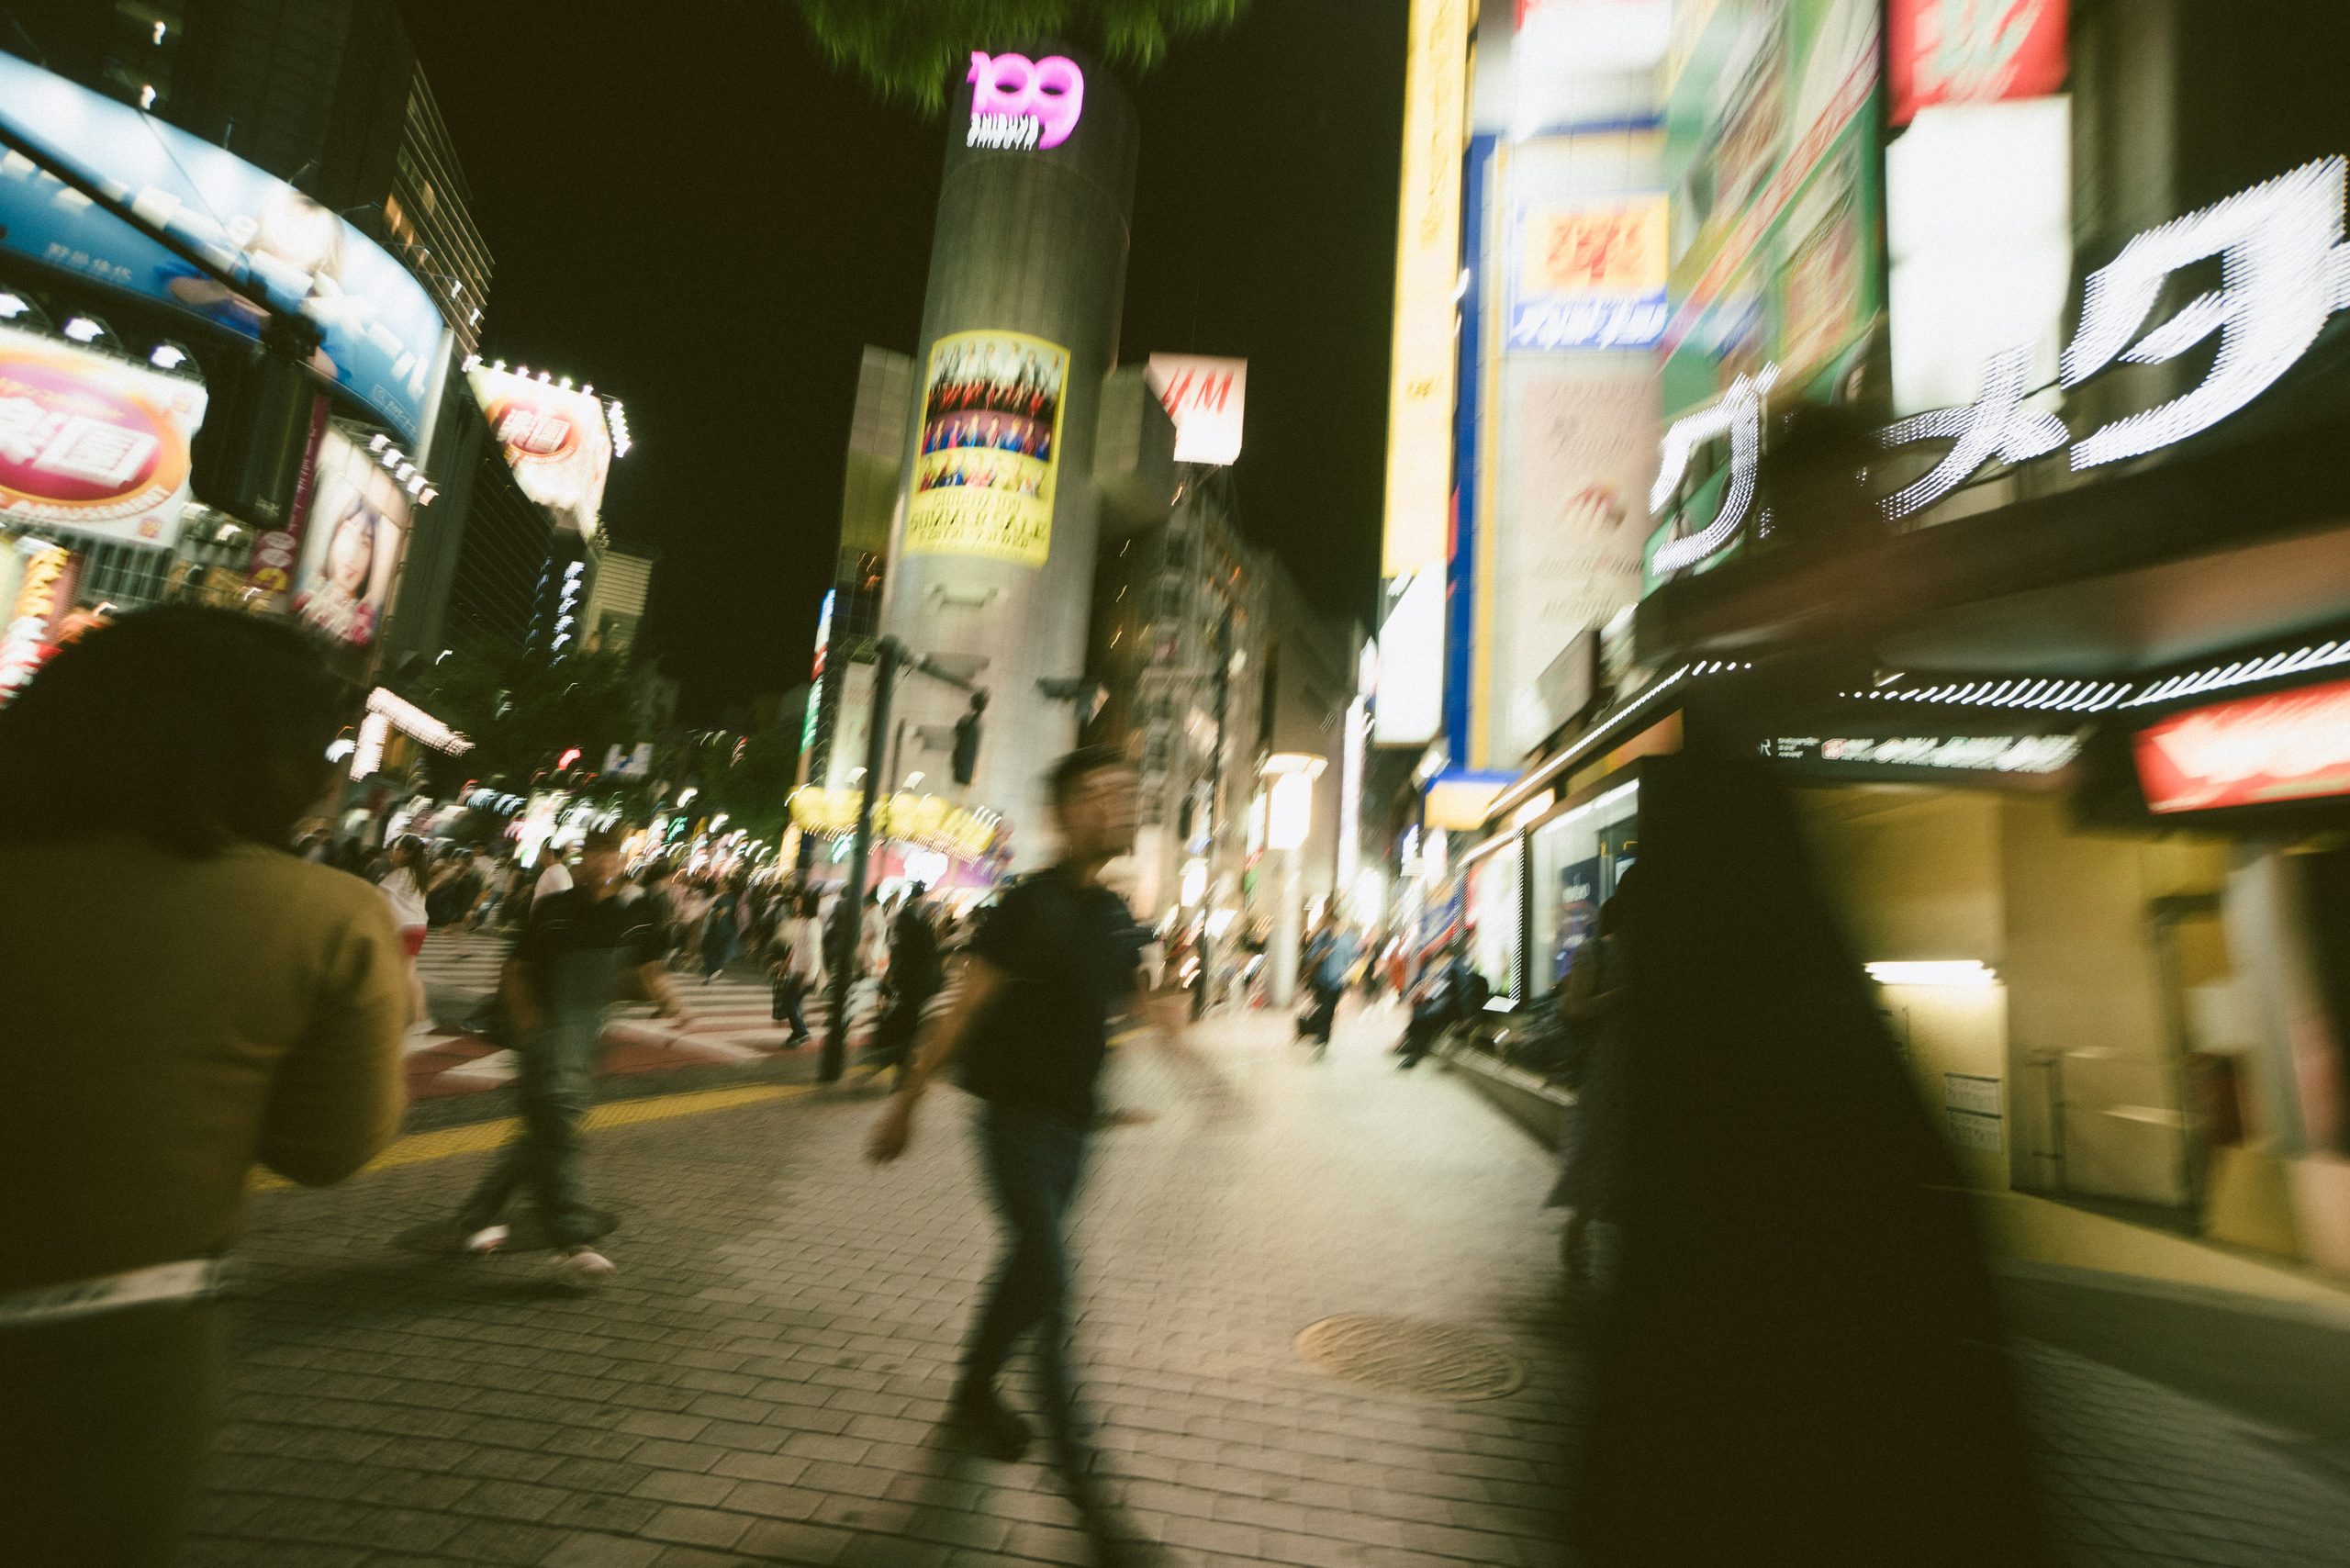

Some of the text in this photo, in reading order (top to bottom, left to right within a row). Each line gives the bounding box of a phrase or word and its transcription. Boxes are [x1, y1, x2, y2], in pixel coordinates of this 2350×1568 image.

[966, 51, 1084, 150] 109
[1649, 153, 2350, 577] グメタ
[911, 509, 989, 532] SUMMER
